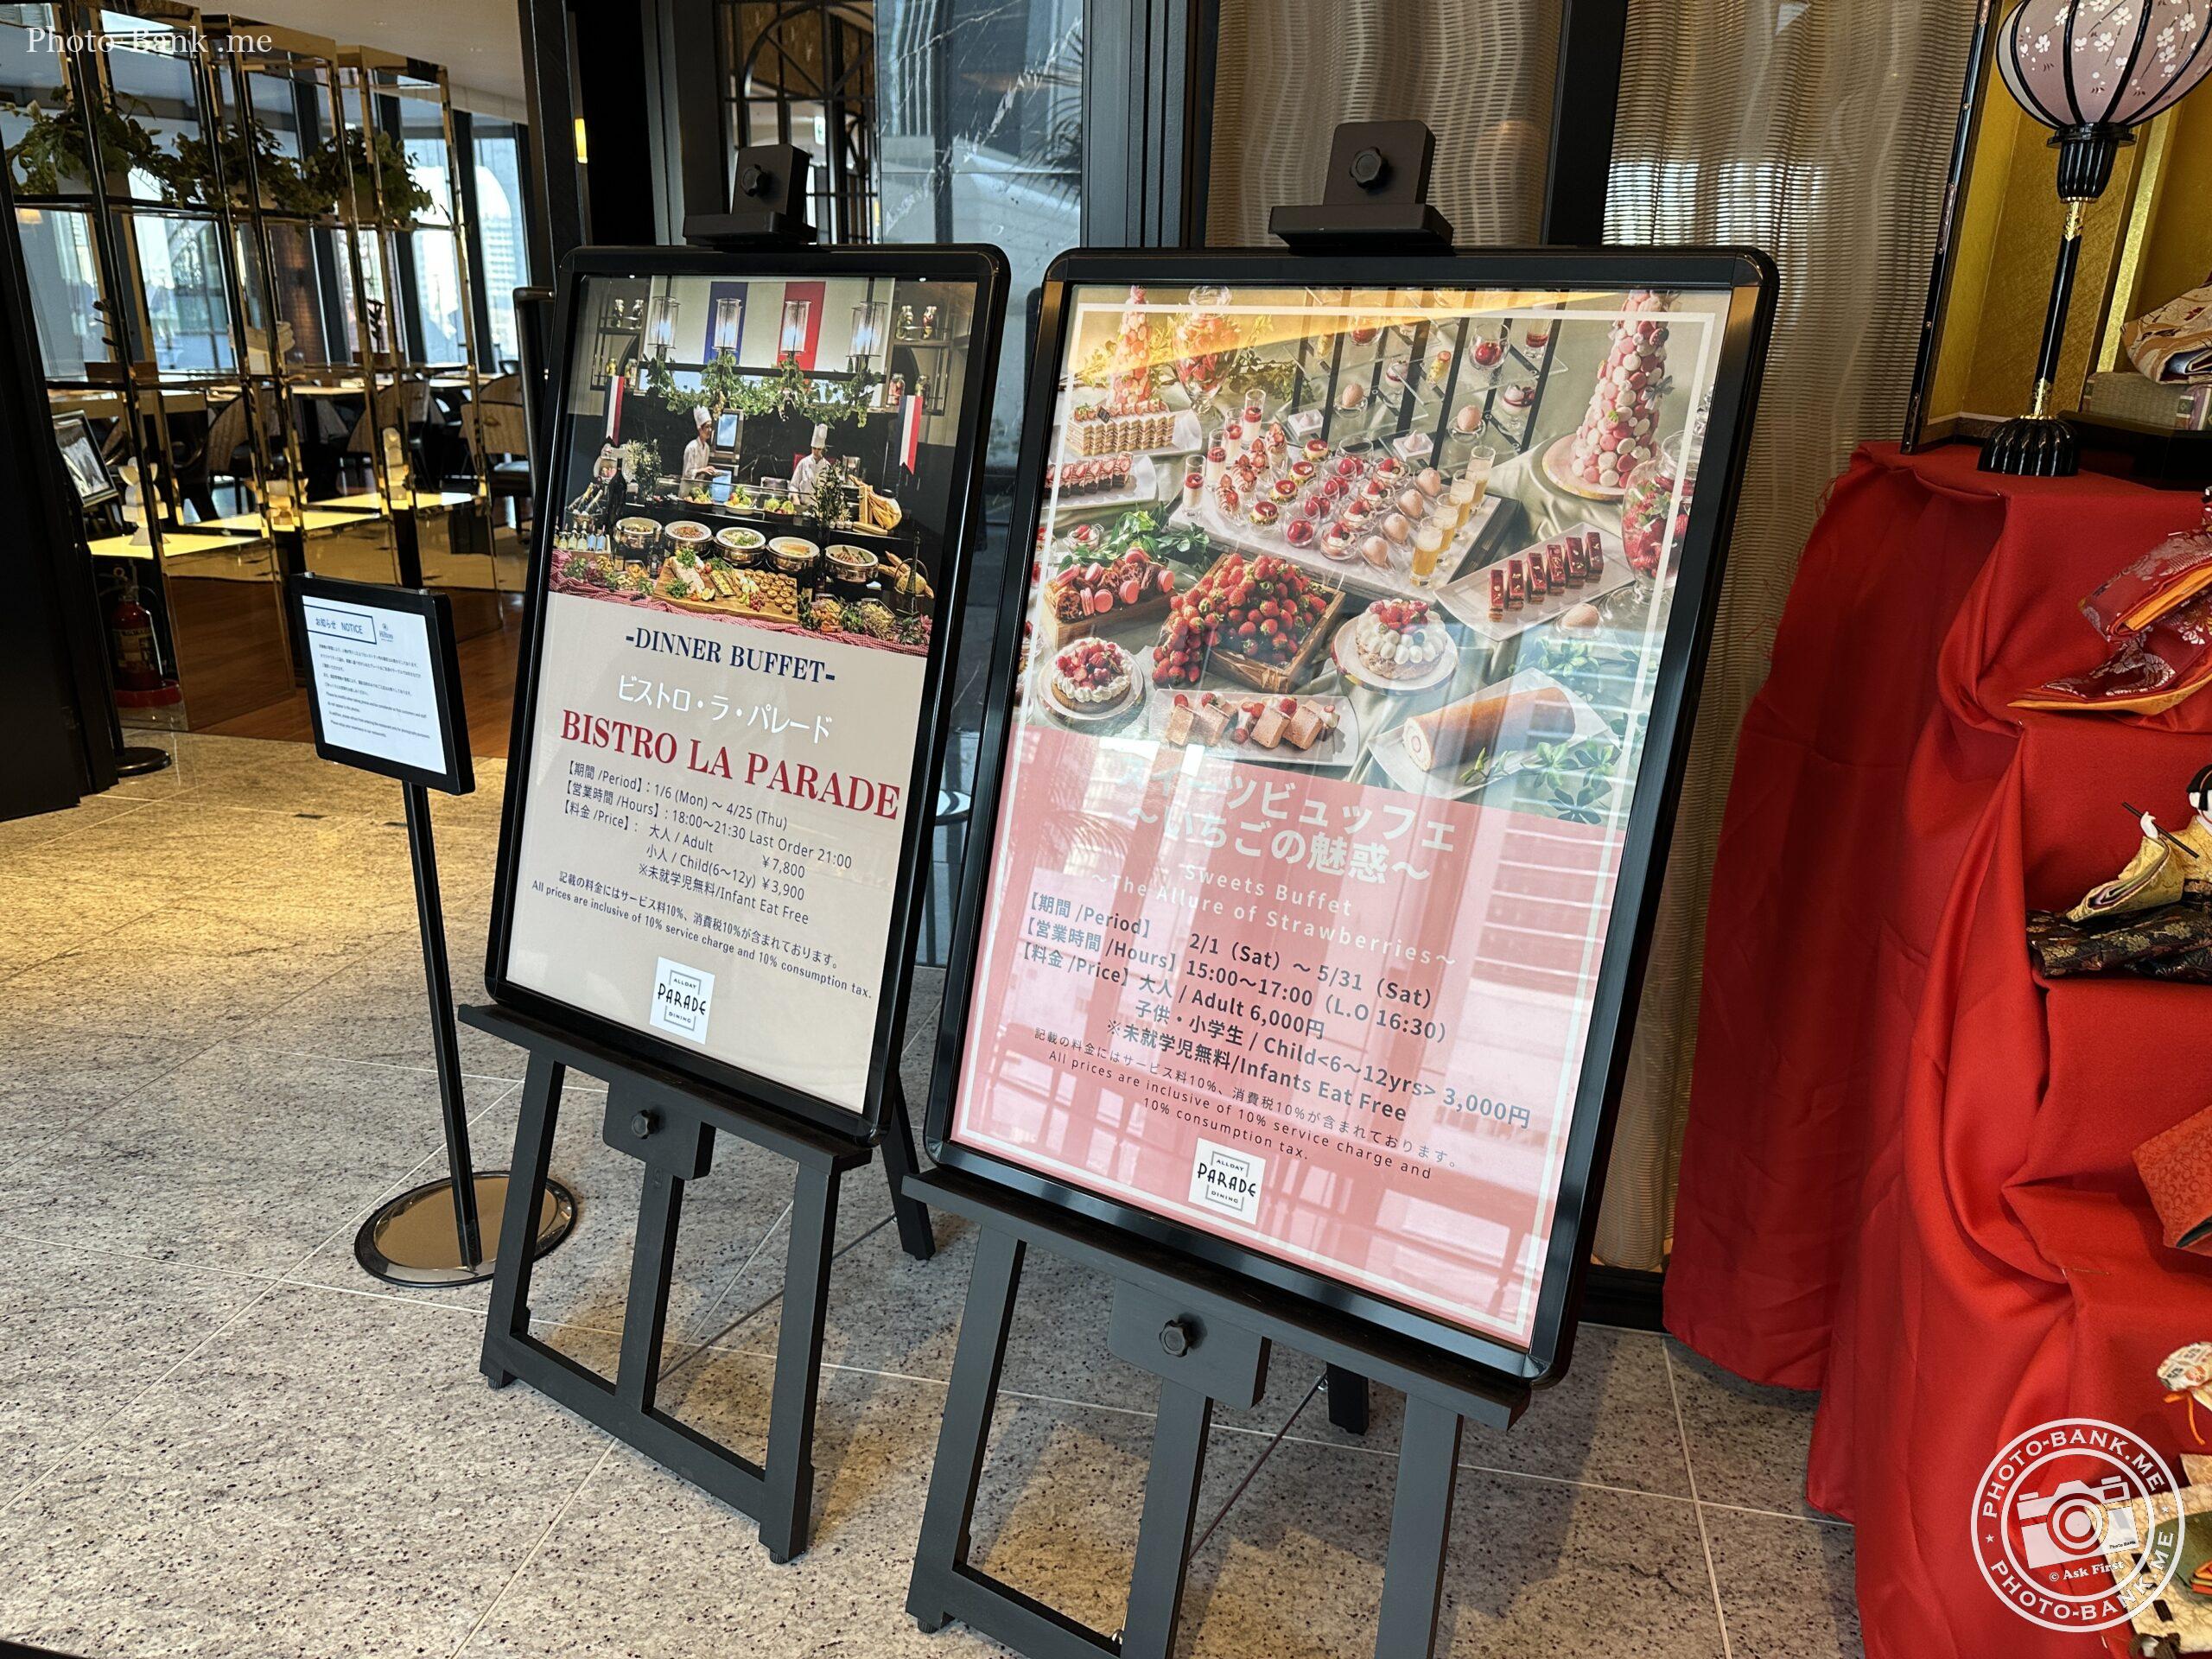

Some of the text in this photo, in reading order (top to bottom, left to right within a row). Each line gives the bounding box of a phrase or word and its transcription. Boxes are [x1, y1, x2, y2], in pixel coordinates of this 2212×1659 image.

[315, 617, 363, 634] お知らせ NOTICE
[618, 675, 832, 744] ビストロ・ラ・パレード
[560, 709, 901, 820] BISTRO LA PARADE
[675, 790, 708, 810] (Mon)
[726, 803, 753, 820] 4/25
[756, 810, 787, 830] (Thu)
[646, 843, 668, 862] 小人
[649, 823, 671, 842] 大人
[683, 834, 714, 853] Adult
[749, 830, 774, 848] Last
[778, 838, 814, 858] Order
[817, 849, 852, 869] 21:00
[1156, 885, 1224, 915] Allure
[1234, 904, 1258, 923] of
[1185, 864, 1351, 916] Sweets Buffet
[760, 899, 779, 914] Eat
[782, 906, 810, 925] Free
[531, 880, 872, 999] All prices are inclusive of 10% service charge and 10% consumption tax.
[1189, 932, 1218, 955] 2/1
[1317, 964, 1363, 991] 5/31
[658, 982, 707, 1015] PARADE
[674, 978, 696, 989] ALLDAY
[668, 1011, 691, 1023] DINING
[1139, 974, 1173, 999] 大人
[1192, 989, 1244, 1017] Adult
[1249, 1005, 1325, 1040] 6,000円
[1049, 1051, 1431, 1179] All prices are inclusive of 10% service charge and
[1318, 1081, 1352, 1106] Eat
[1359, 1092, 1407, 1122] Free
[1442, 1087, 1530, 1129] 3,000円
[1144, 1098, 1307, 1160] 10% consumption tax.
[1197, 1162, 1256, 1197] PARADE
[1216, 1159, 1244, 1172] ALLDAY
[1211, 1190, 1238, 1204] DINING
